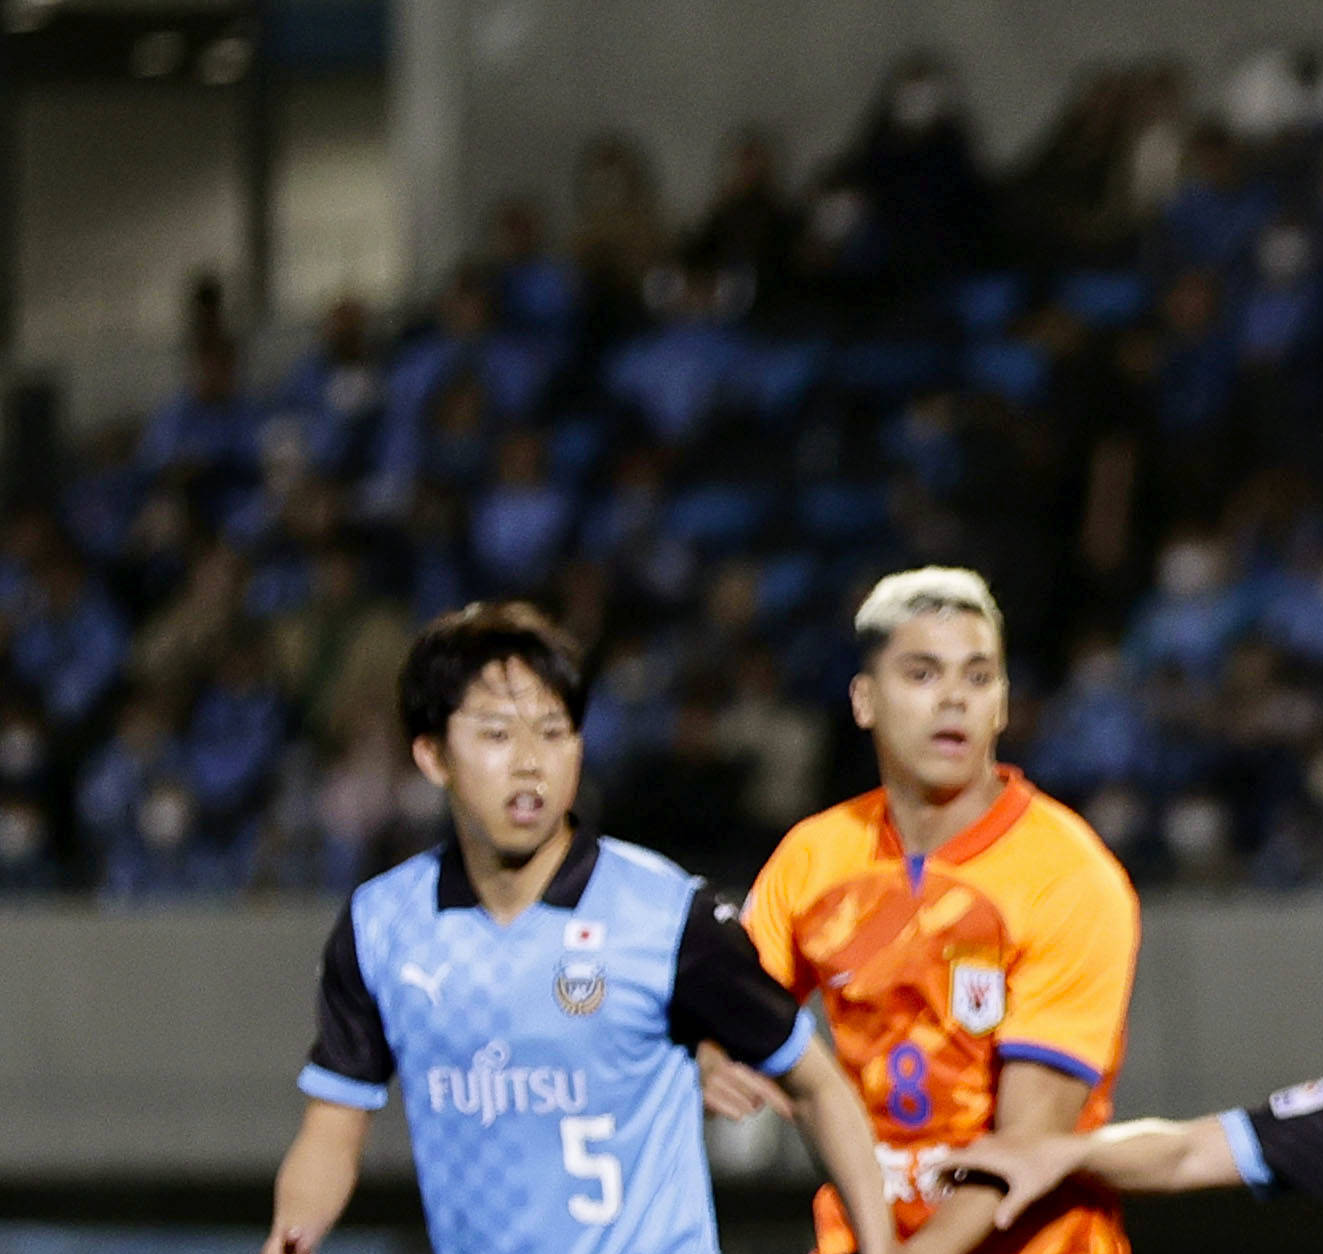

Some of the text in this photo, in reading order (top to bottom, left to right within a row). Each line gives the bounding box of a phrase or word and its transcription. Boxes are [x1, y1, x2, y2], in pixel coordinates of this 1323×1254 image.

[427, 1040, 588, 1128] FUJITSU
[886, 1041, 935, 1130] 8
[560, 1113, 623, 1225] 5
